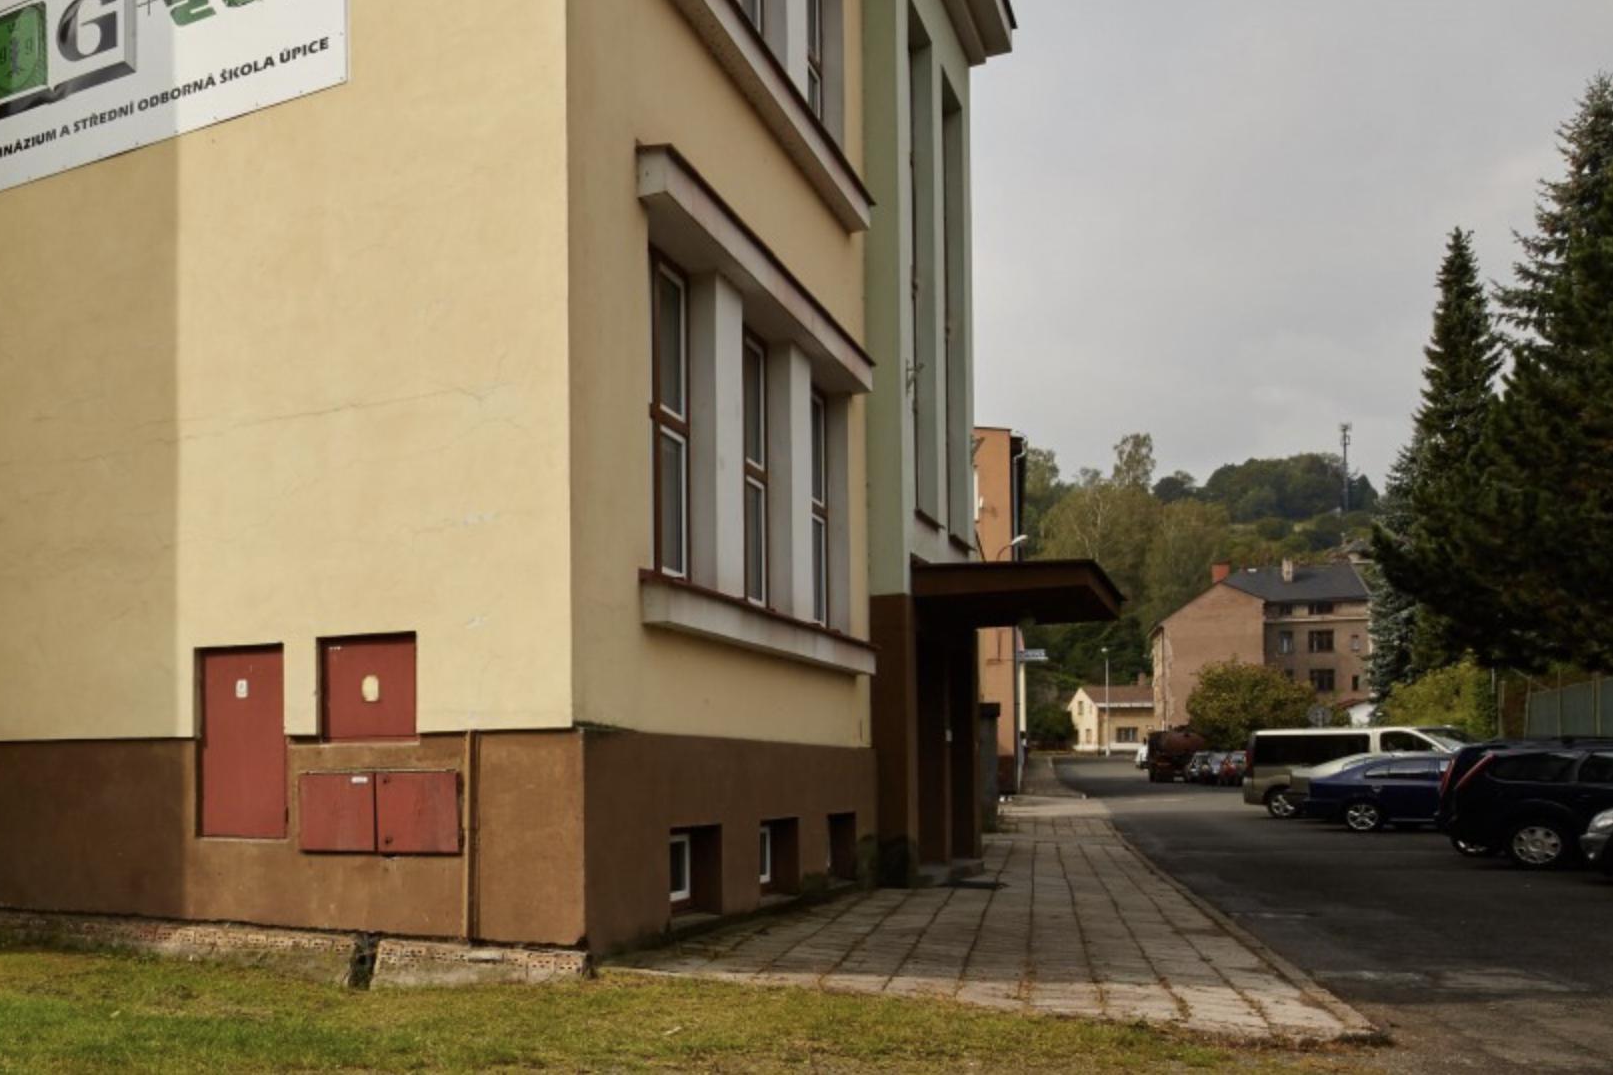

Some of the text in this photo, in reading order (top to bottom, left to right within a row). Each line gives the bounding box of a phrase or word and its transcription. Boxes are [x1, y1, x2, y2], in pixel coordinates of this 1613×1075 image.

[59, 124, 71, 138] A
[73, 102, 135, 133] STŘEDNÍ
[137, 73, 216, 112] ODBORNÁ
[219, 56, 275, 84] ŠKOLA
[279, 36, 330, 64] ÚPICE
